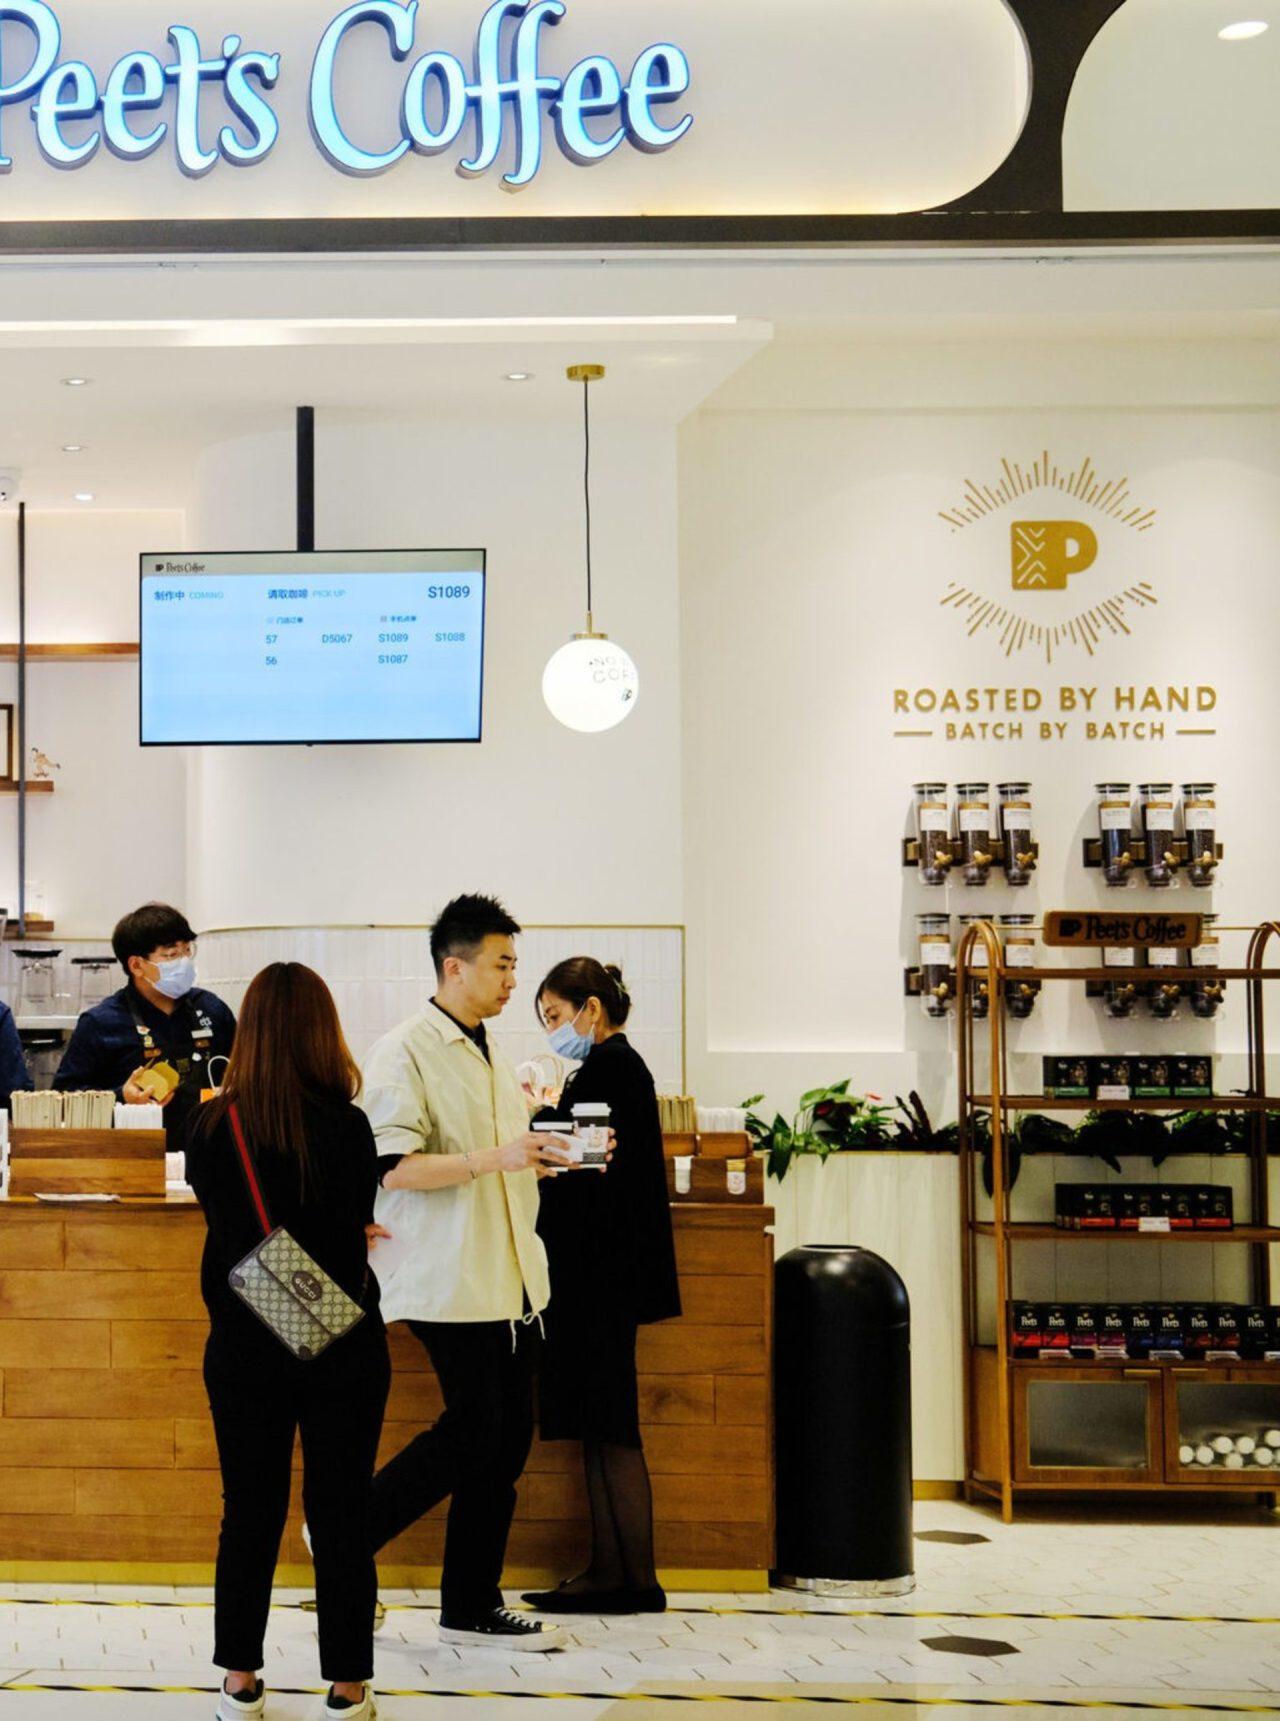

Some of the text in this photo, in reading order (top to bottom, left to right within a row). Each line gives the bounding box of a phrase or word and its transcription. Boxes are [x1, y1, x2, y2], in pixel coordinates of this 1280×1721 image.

[309, 0, 695, 192] Coffee
[427, 585, 471, 599] S1089
[265, 634, 278, 645] 57
[322, 633, 353, 644] D5067
[378, 633, 409, 643] S1089
[893, 685, 1217, 714] ROASTED BY HAND
[945, 722, 1165, 740] BATCH BY BATCH
[1134, 914, 1186, 944] Coffee
